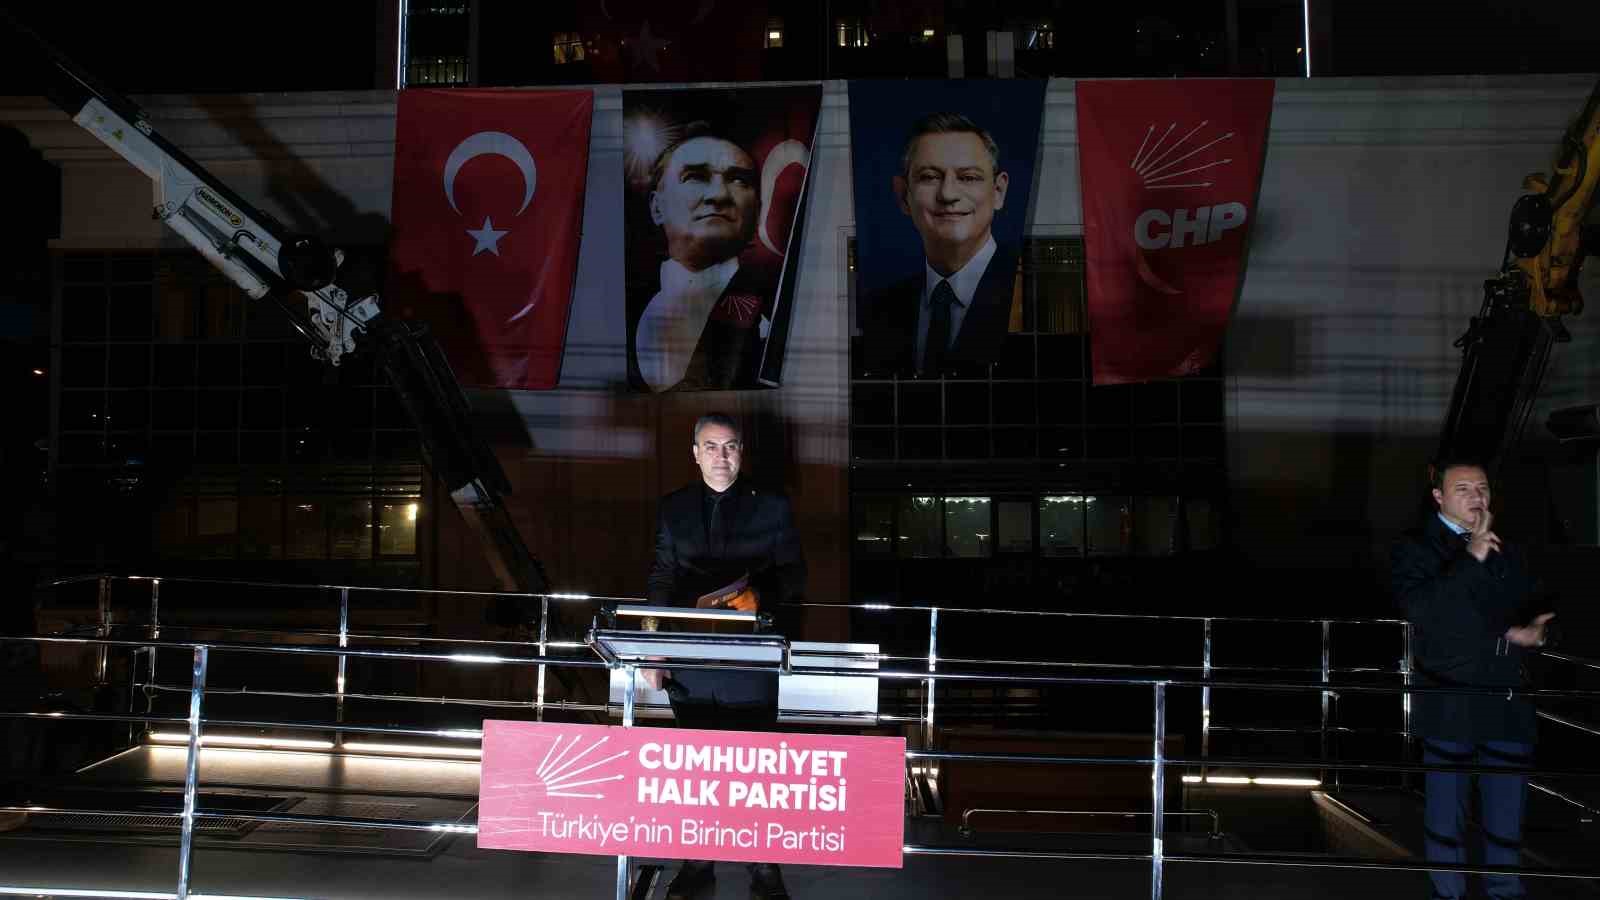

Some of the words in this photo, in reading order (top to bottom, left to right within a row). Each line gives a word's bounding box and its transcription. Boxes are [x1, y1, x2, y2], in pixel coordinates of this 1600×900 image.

[1135, 202, 1248, 250] CHP
[638, 741, 848, 776] CUMHURİYET
[636, 776, 720, 807] HALK
[728, 777, 848, 812] PARTİSİ
[680, 818, 760, 850] Birinci
[767, 823, 846, 852] Partisi
